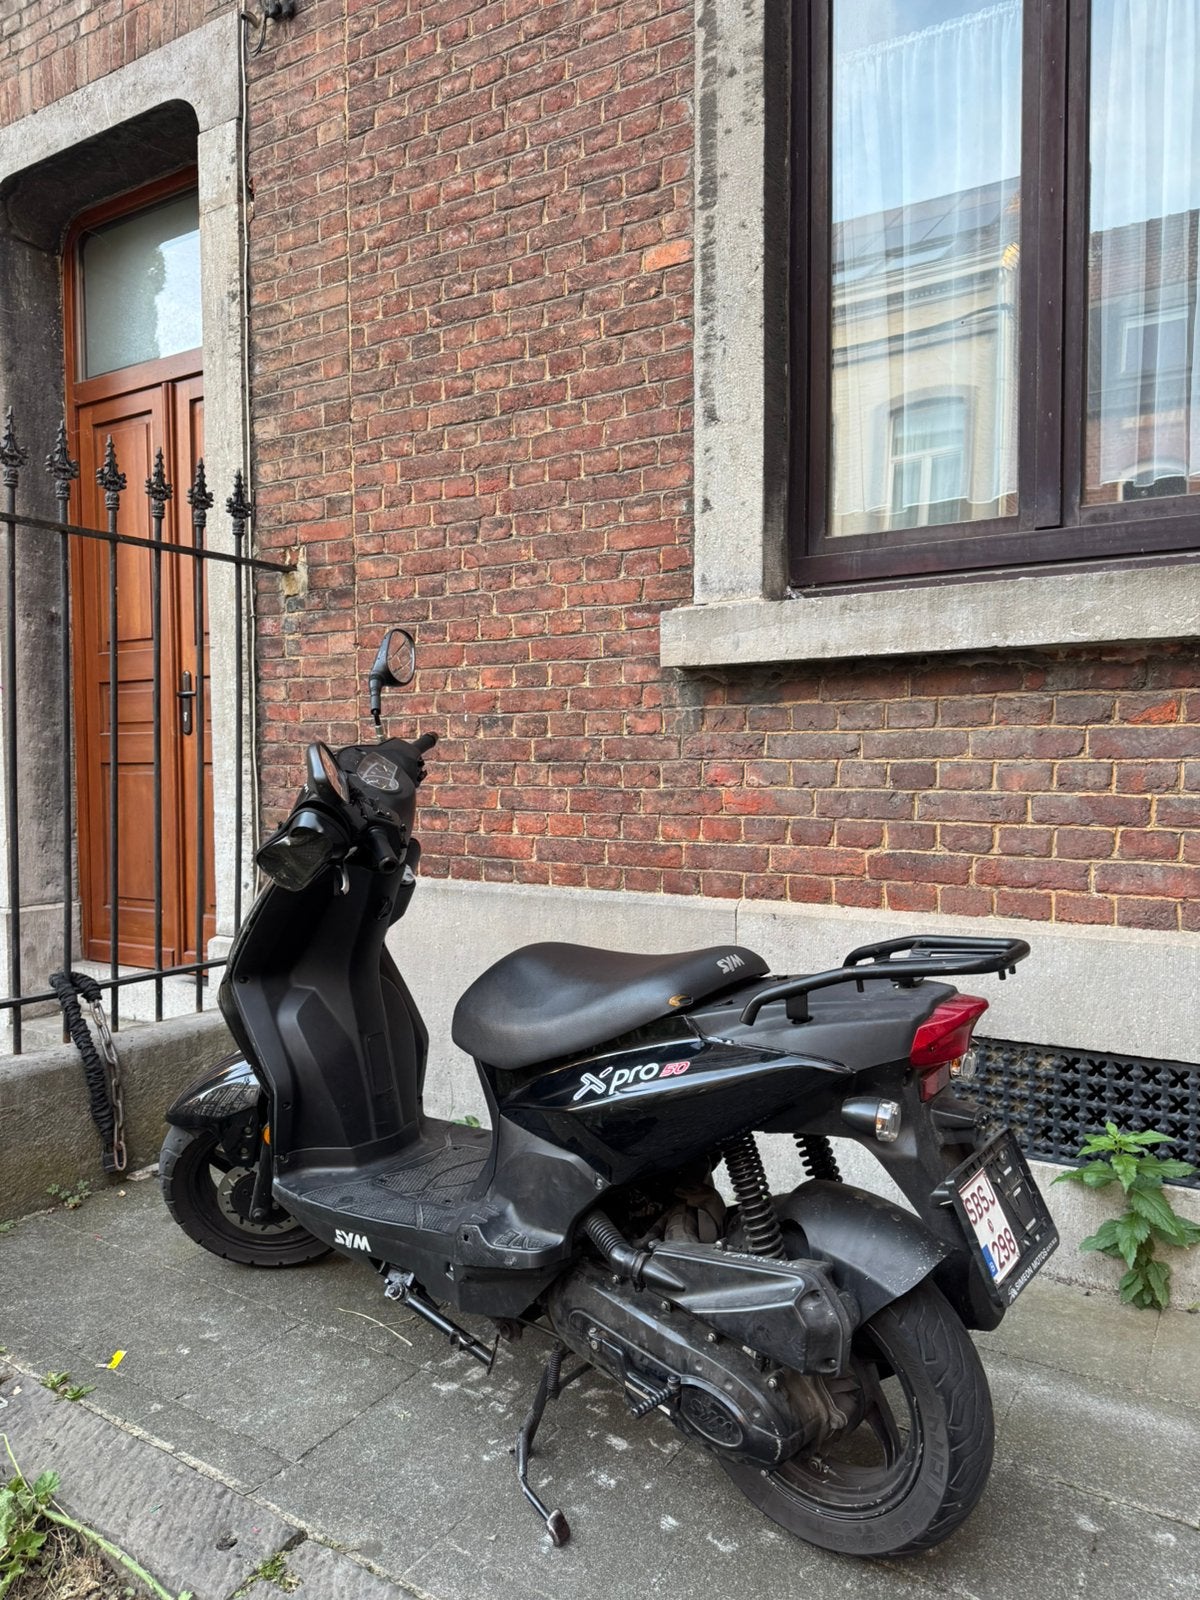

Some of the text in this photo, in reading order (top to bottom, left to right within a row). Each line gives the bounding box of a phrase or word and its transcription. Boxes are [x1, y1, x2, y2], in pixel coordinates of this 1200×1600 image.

[716, 954, 745, 974] SYM
[660, 1061, 691, 1078] 50
[963, 1177, 996, 1226] SBSJ
[334, 1229, 372, 1252] SYM
[991, 1227, 1016, 1269] 298
